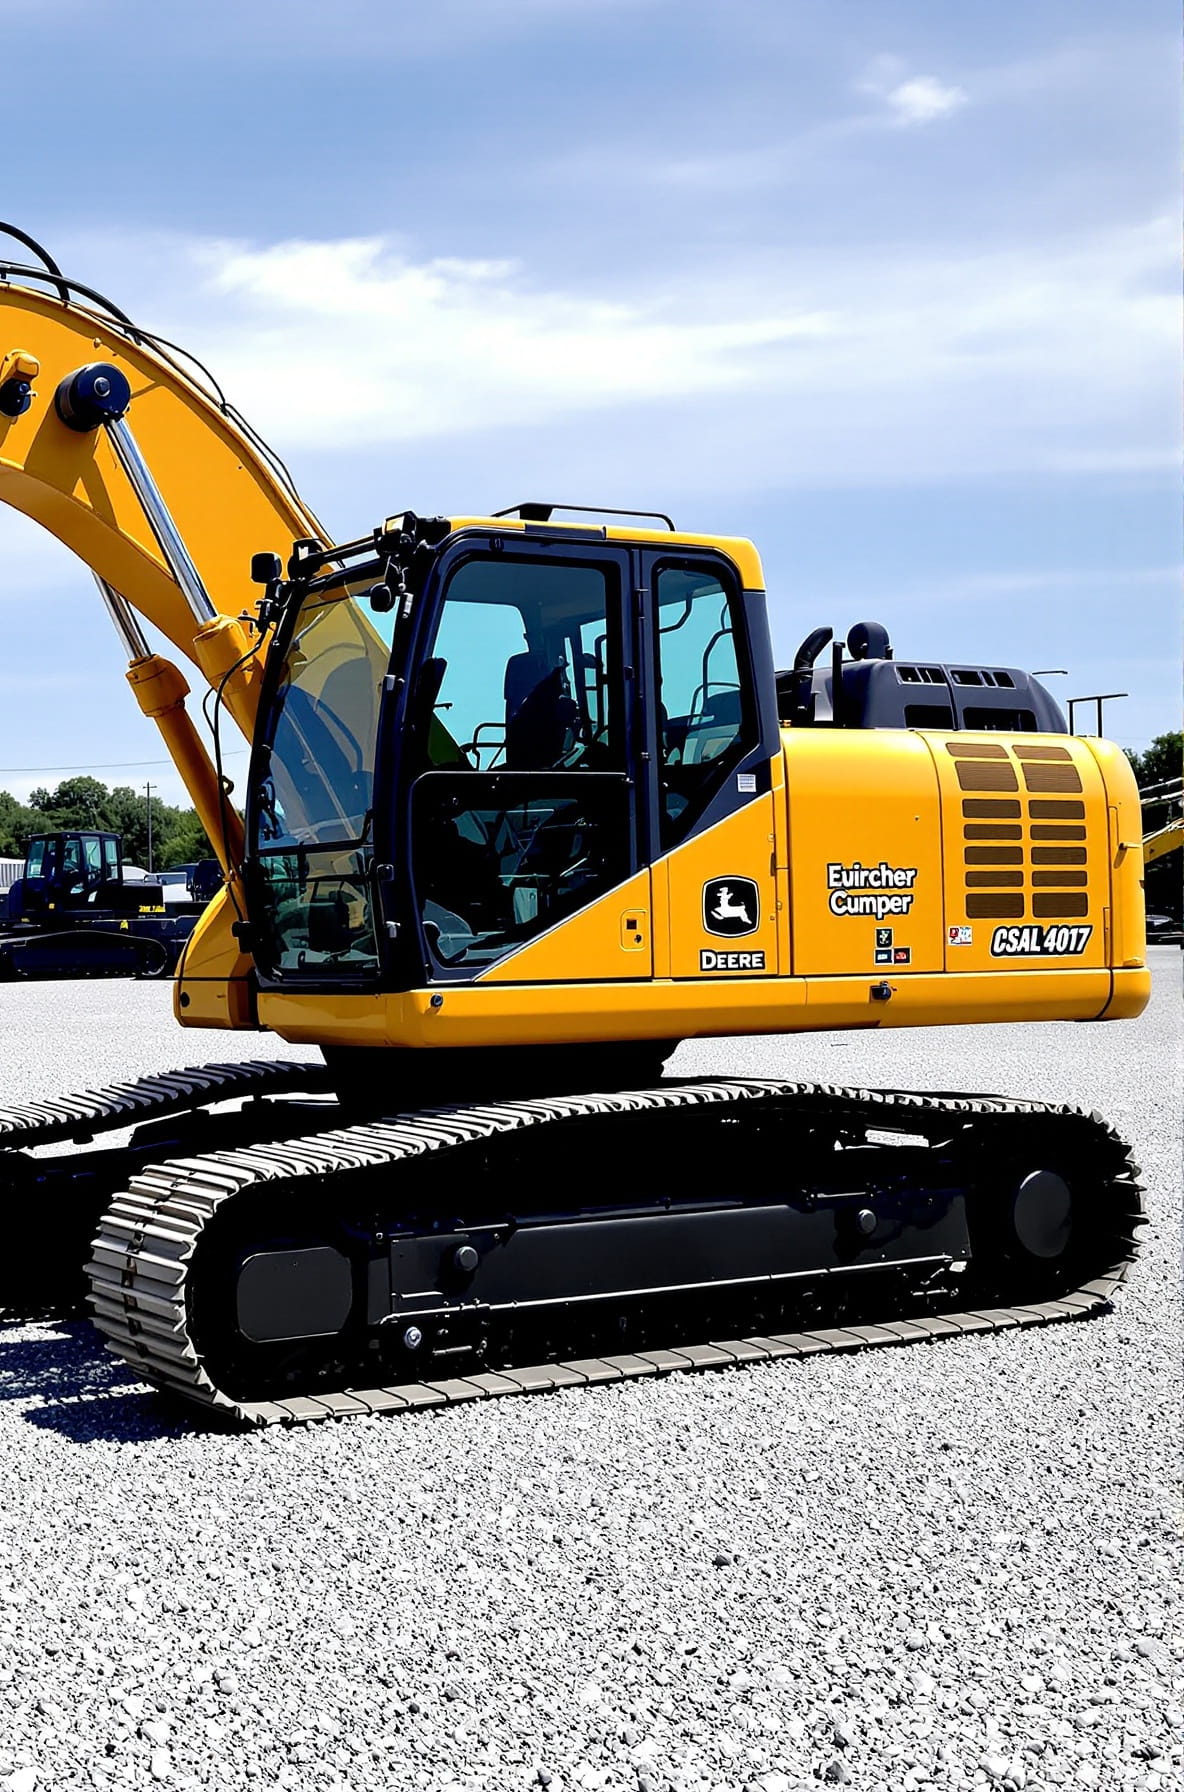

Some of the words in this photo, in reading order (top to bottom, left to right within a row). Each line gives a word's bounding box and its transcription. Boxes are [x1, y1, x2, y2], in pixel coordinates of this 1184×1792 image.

[830, 890, 913, 919] Cumper
[993, 927, 1041, 953] CSAL
[1043, 926, 1091, 952] 4017
[701, 951, 764, 970] DEERE
